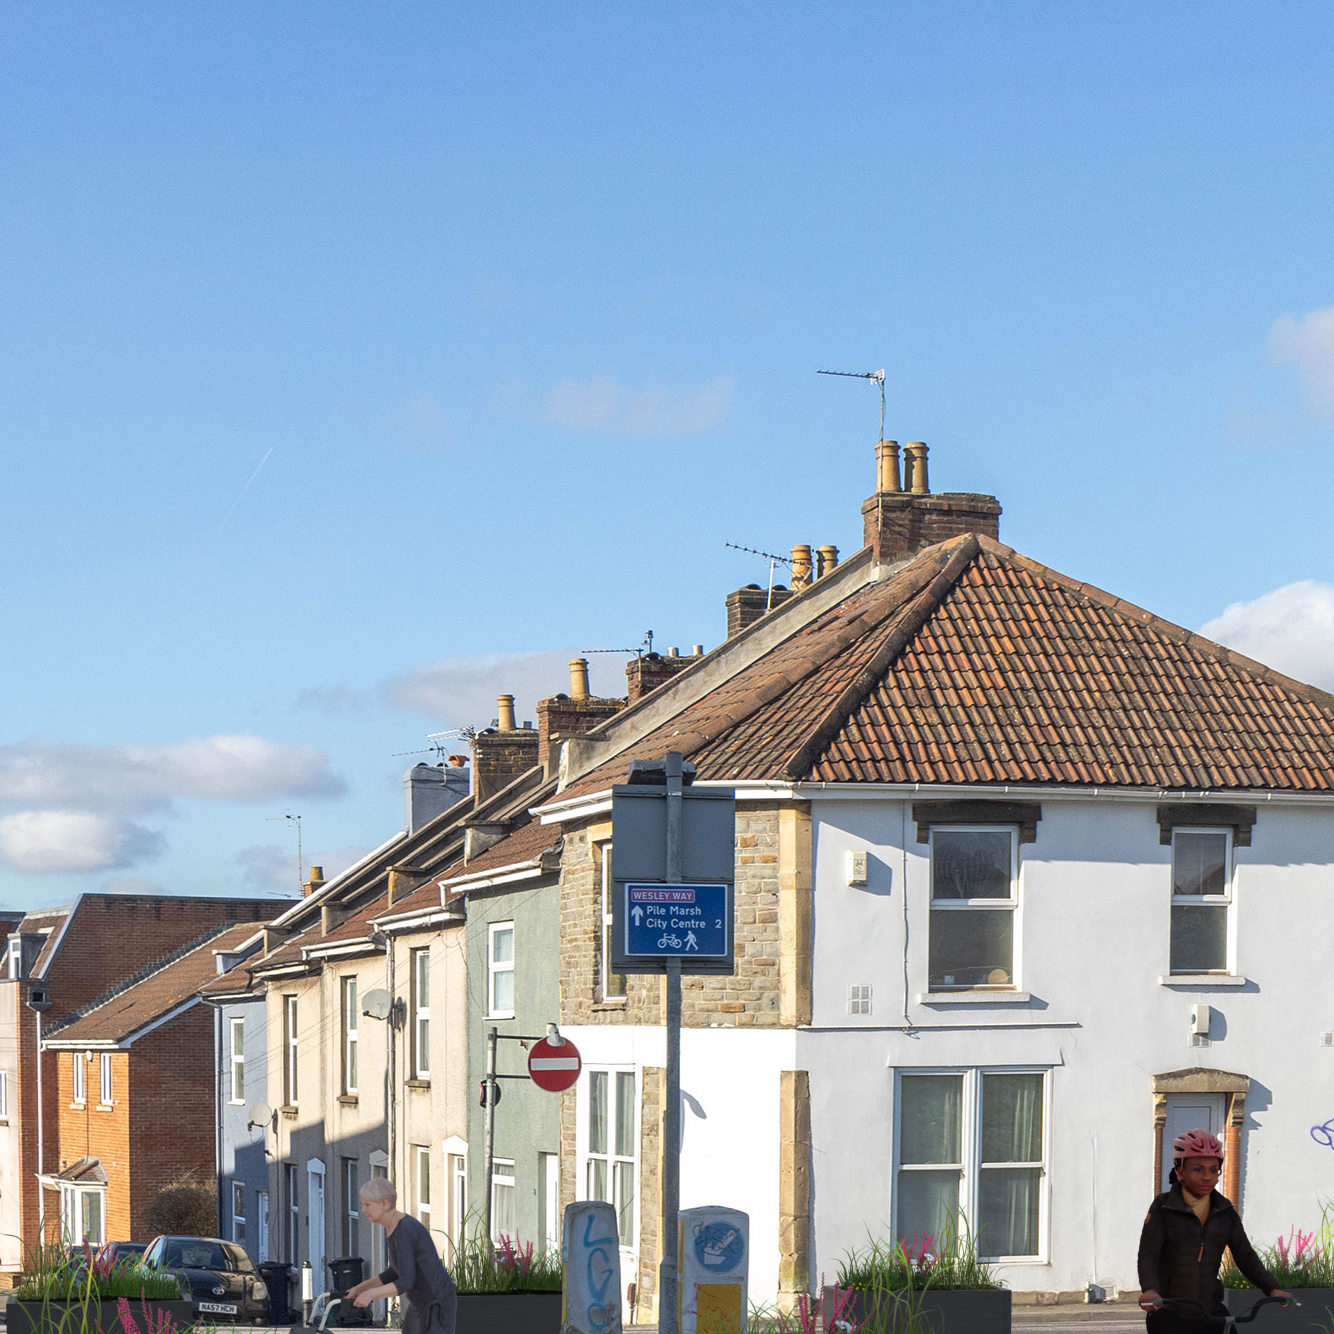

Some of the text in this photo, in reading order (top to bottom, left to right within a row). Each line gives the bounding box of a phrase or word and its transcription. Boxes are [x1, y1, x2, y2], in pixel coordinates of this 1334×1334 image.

[633, 892, 693, 900] WESLEY WAY
[646, 905, 701, 915] Pile Marsh
[646, 918, 722, 930] City Centre 2
